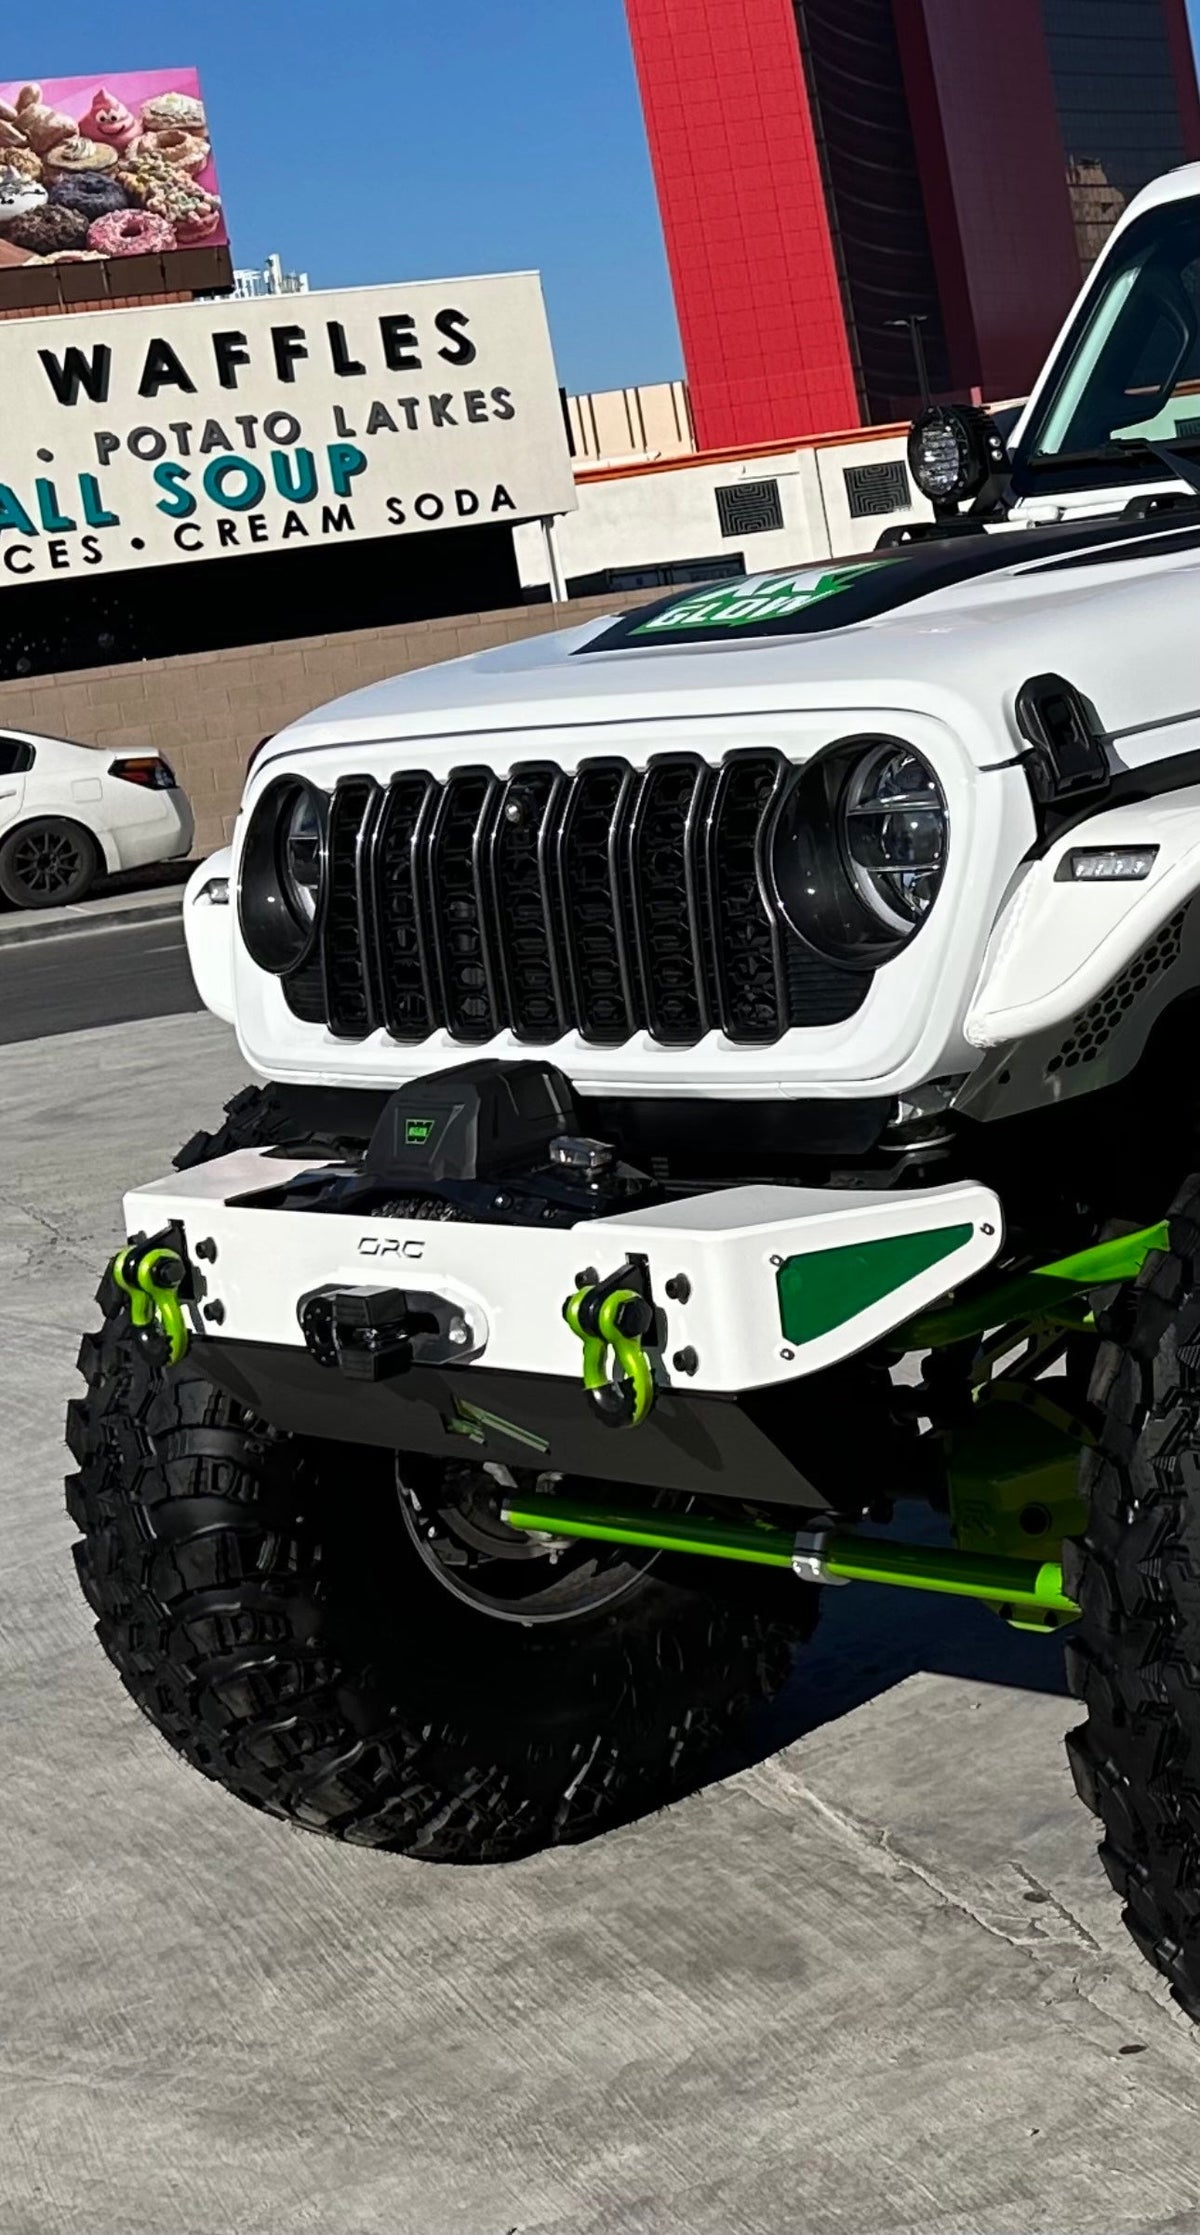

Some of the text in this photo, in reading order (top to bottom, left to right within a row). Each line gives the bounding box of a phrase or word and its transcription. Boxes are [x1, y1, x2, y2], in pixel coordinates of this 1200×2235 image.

[37, 308, 477, 406] WAFFLES
[94, 386, 516, 466] POTATO LATKES
[153, 442, 368, 519] SOUP
[3, 484, 517, 574] CES CREAM SODA
